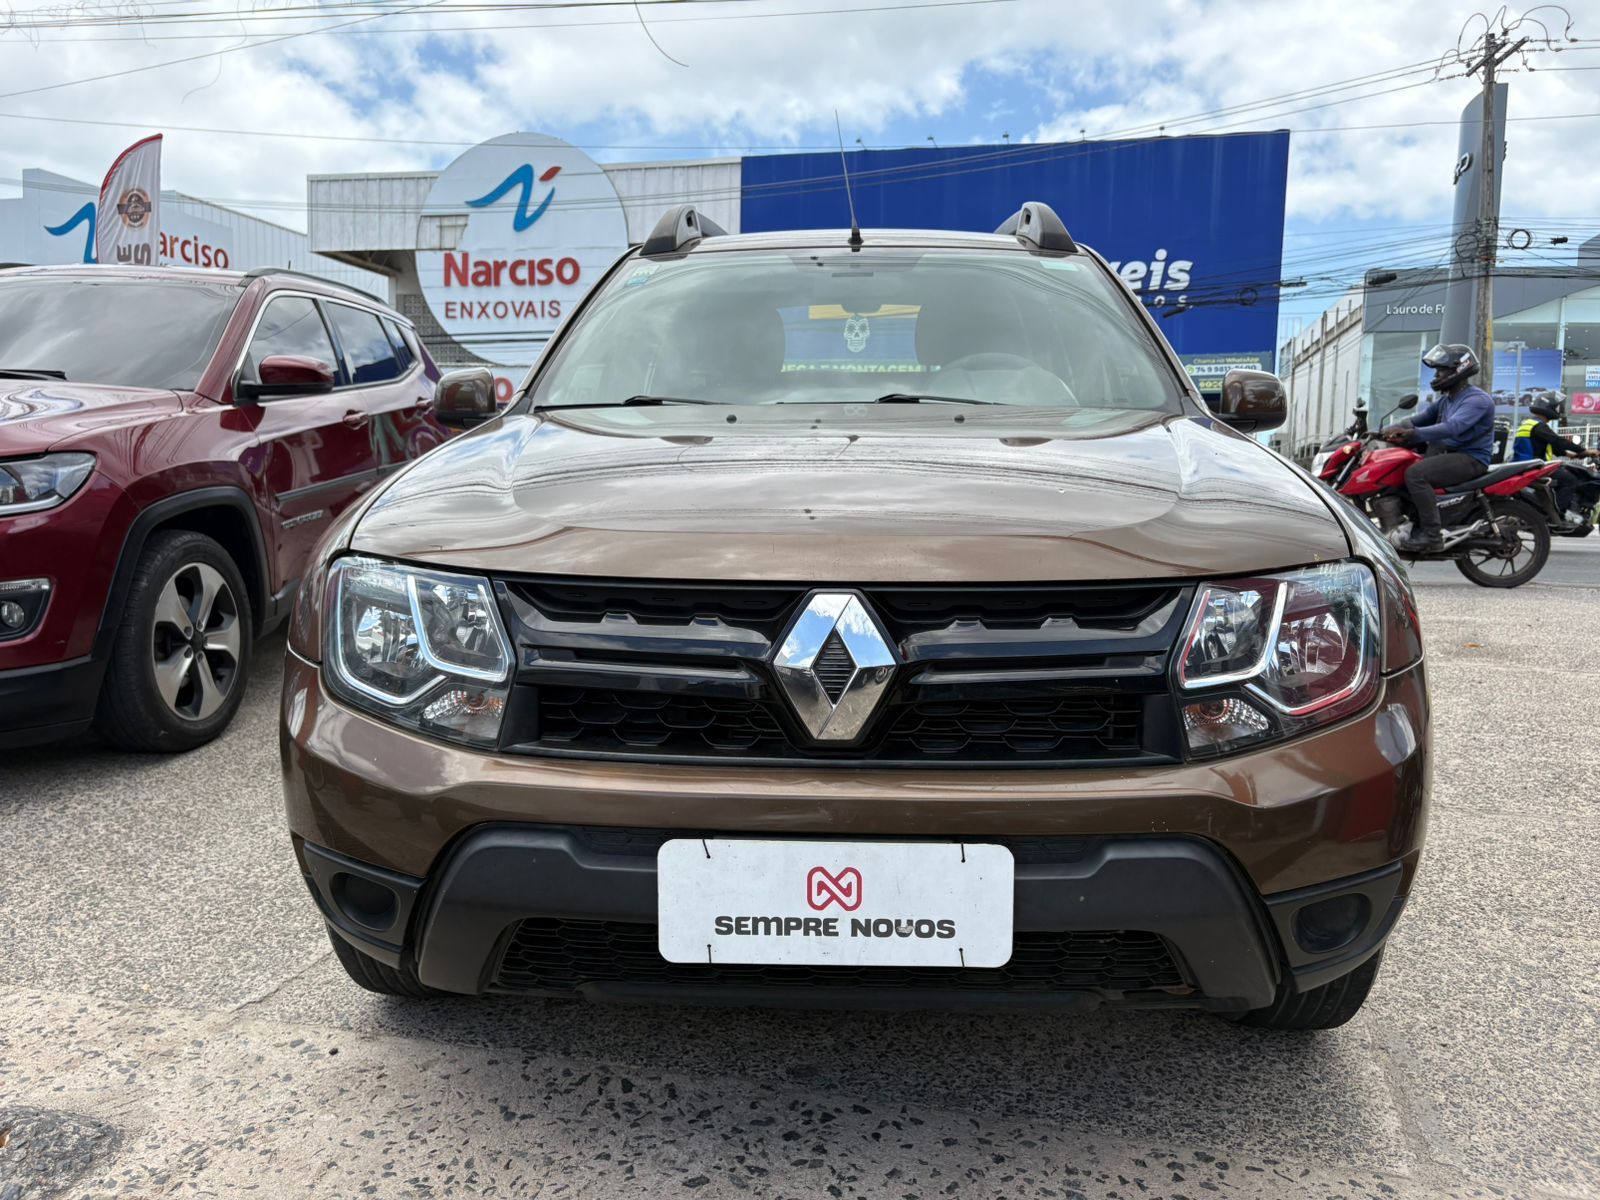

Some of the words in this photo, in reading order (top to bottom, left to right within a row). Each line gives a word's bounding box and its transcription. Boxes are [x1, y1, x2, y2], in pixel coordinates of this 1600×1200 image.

[160, 231, 229, 269] arciso
[443, 252, 581, 288] Narciso
[445, 300, 561, 320] ENXOVAIS
[1386, 304, 1418, 315] Lauro
[1419, 303, 1433, 314] de
[715, 916, 840, 937] SEMPRE
